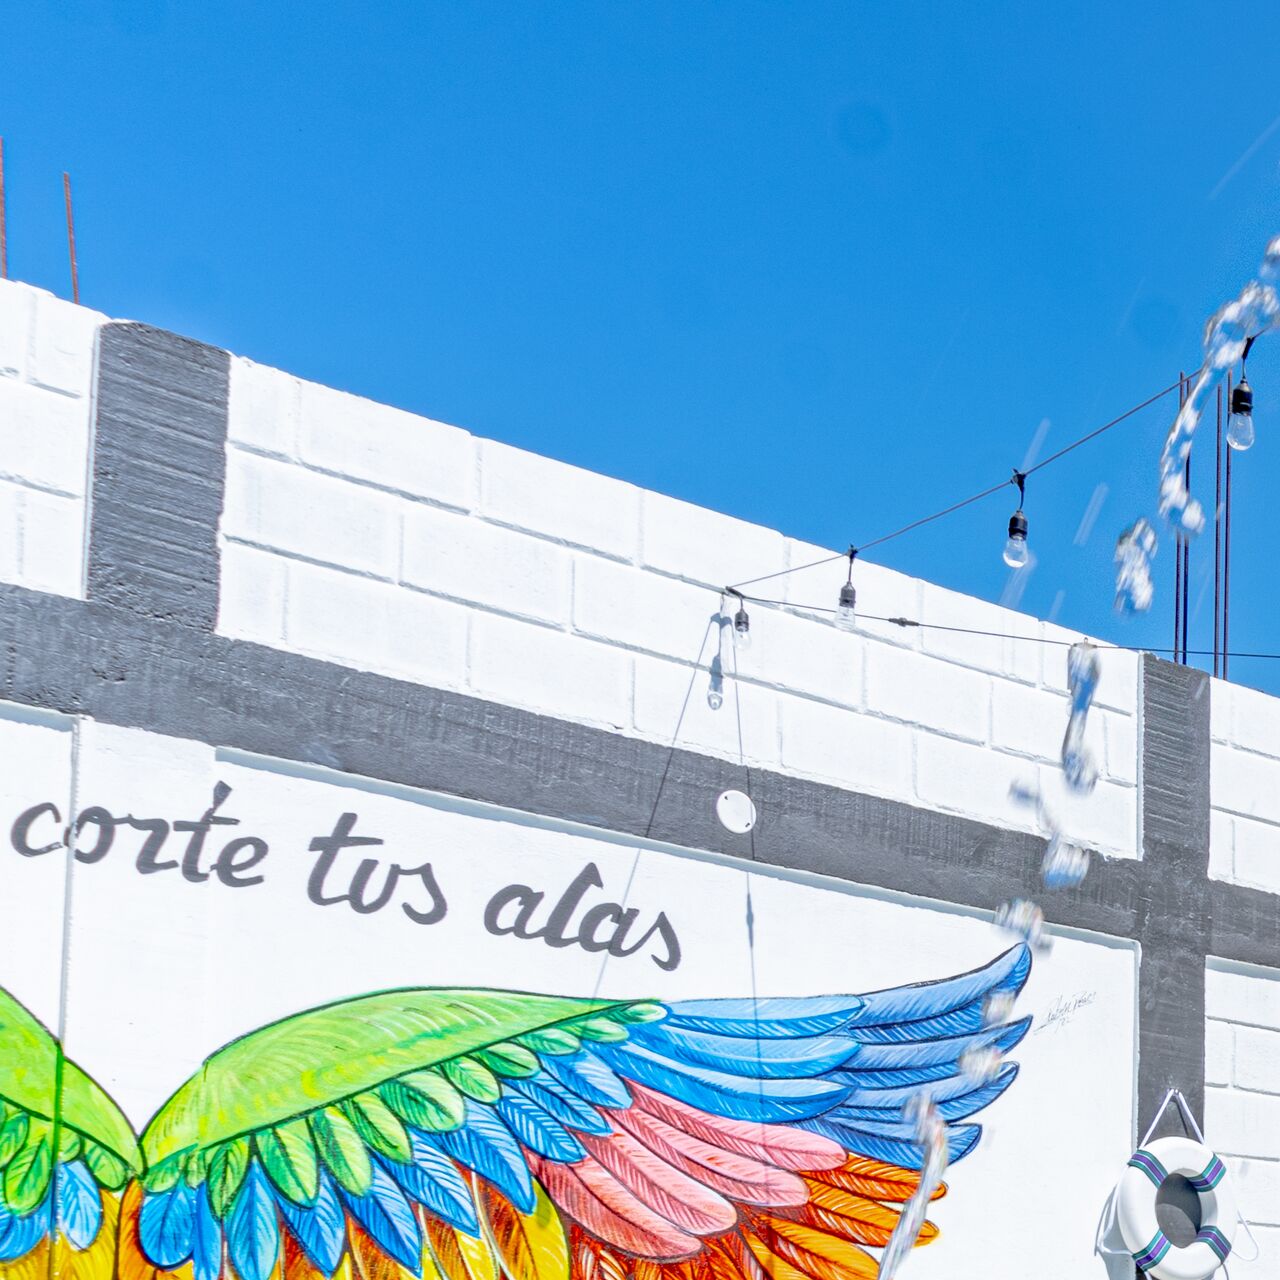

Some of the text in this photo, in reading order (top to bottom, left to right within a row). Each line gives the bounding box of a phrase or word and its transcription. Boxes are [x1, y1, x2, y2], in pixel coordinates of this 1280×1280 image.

[10, 780, 681, 972] corte tus alas
